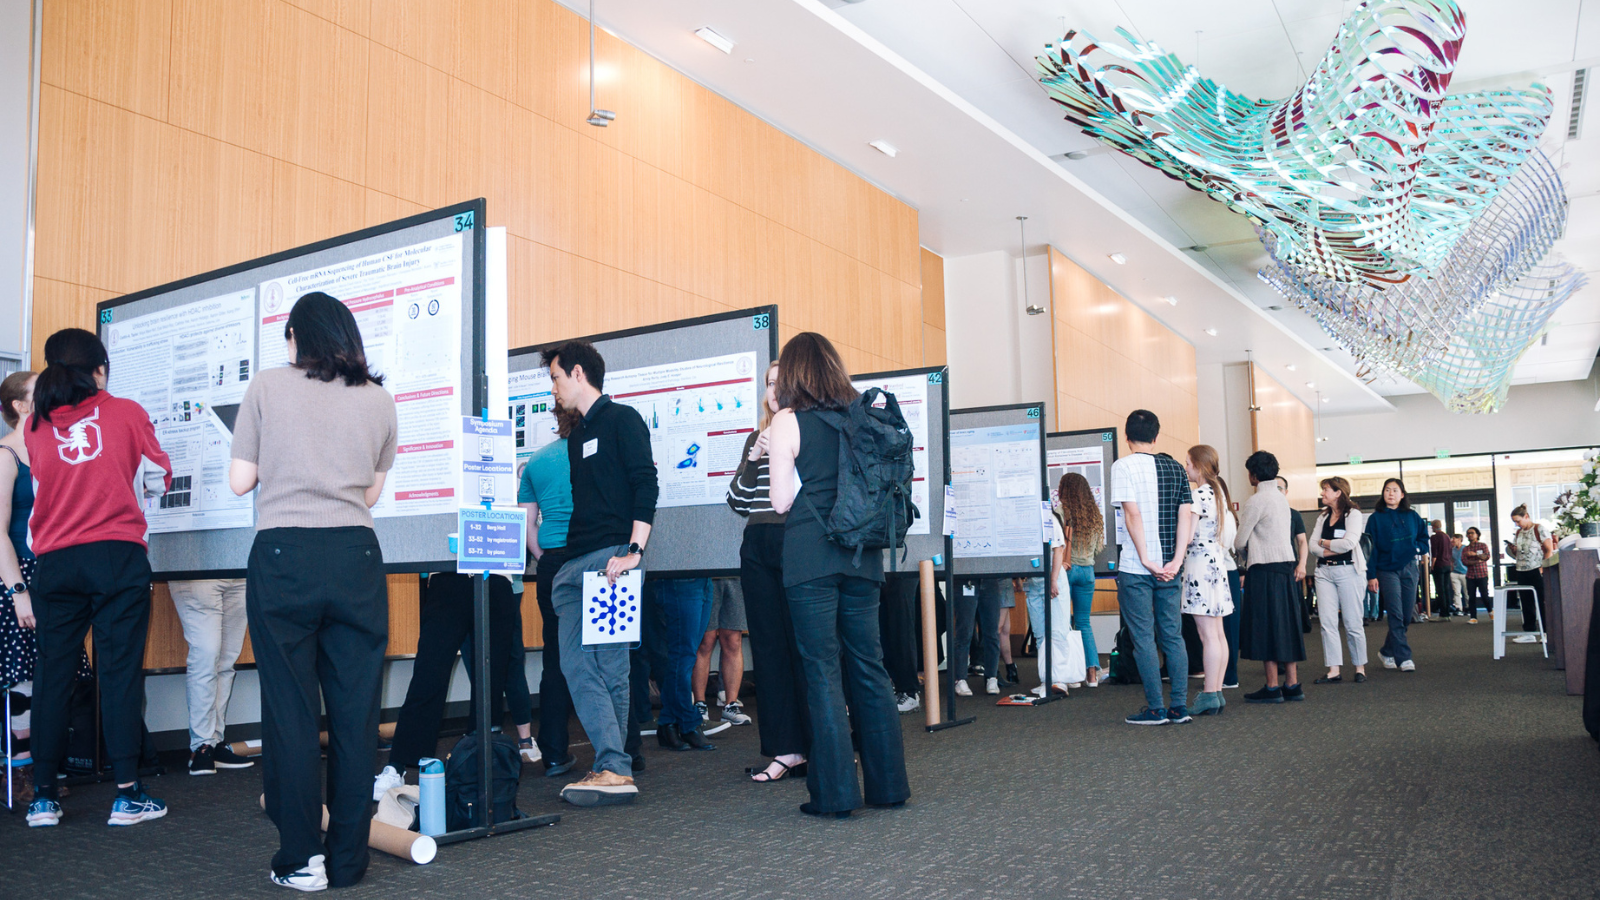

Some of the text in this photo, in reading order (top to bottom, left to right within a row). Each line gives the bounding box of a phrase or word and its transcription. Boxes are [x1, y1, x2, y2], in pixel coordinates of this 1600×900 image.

[455, 214, 474, 232] 34
[328, 264, 354, 276] Sequencing
[362, 257, 382, 267] Human
[404, 246, 432, 256] Molecular
[296, 278, 335, 292] Characterization
[342, 272, 358, 281] Severe
[360, 266, 385, 278] Traumatic
[386, 263, 402, 271] Brain
[403, 258, 420, 267] Injury
[101, 310, 112, 324] 33
[754, 316, 769, 329] 38
[928, 373, 942, 383] 42
[1027, 408, 1039, 417] 46
[470, 419, 504, 428] Symposium
[462, 510, 524, 520] POSTER LOCATIONS
